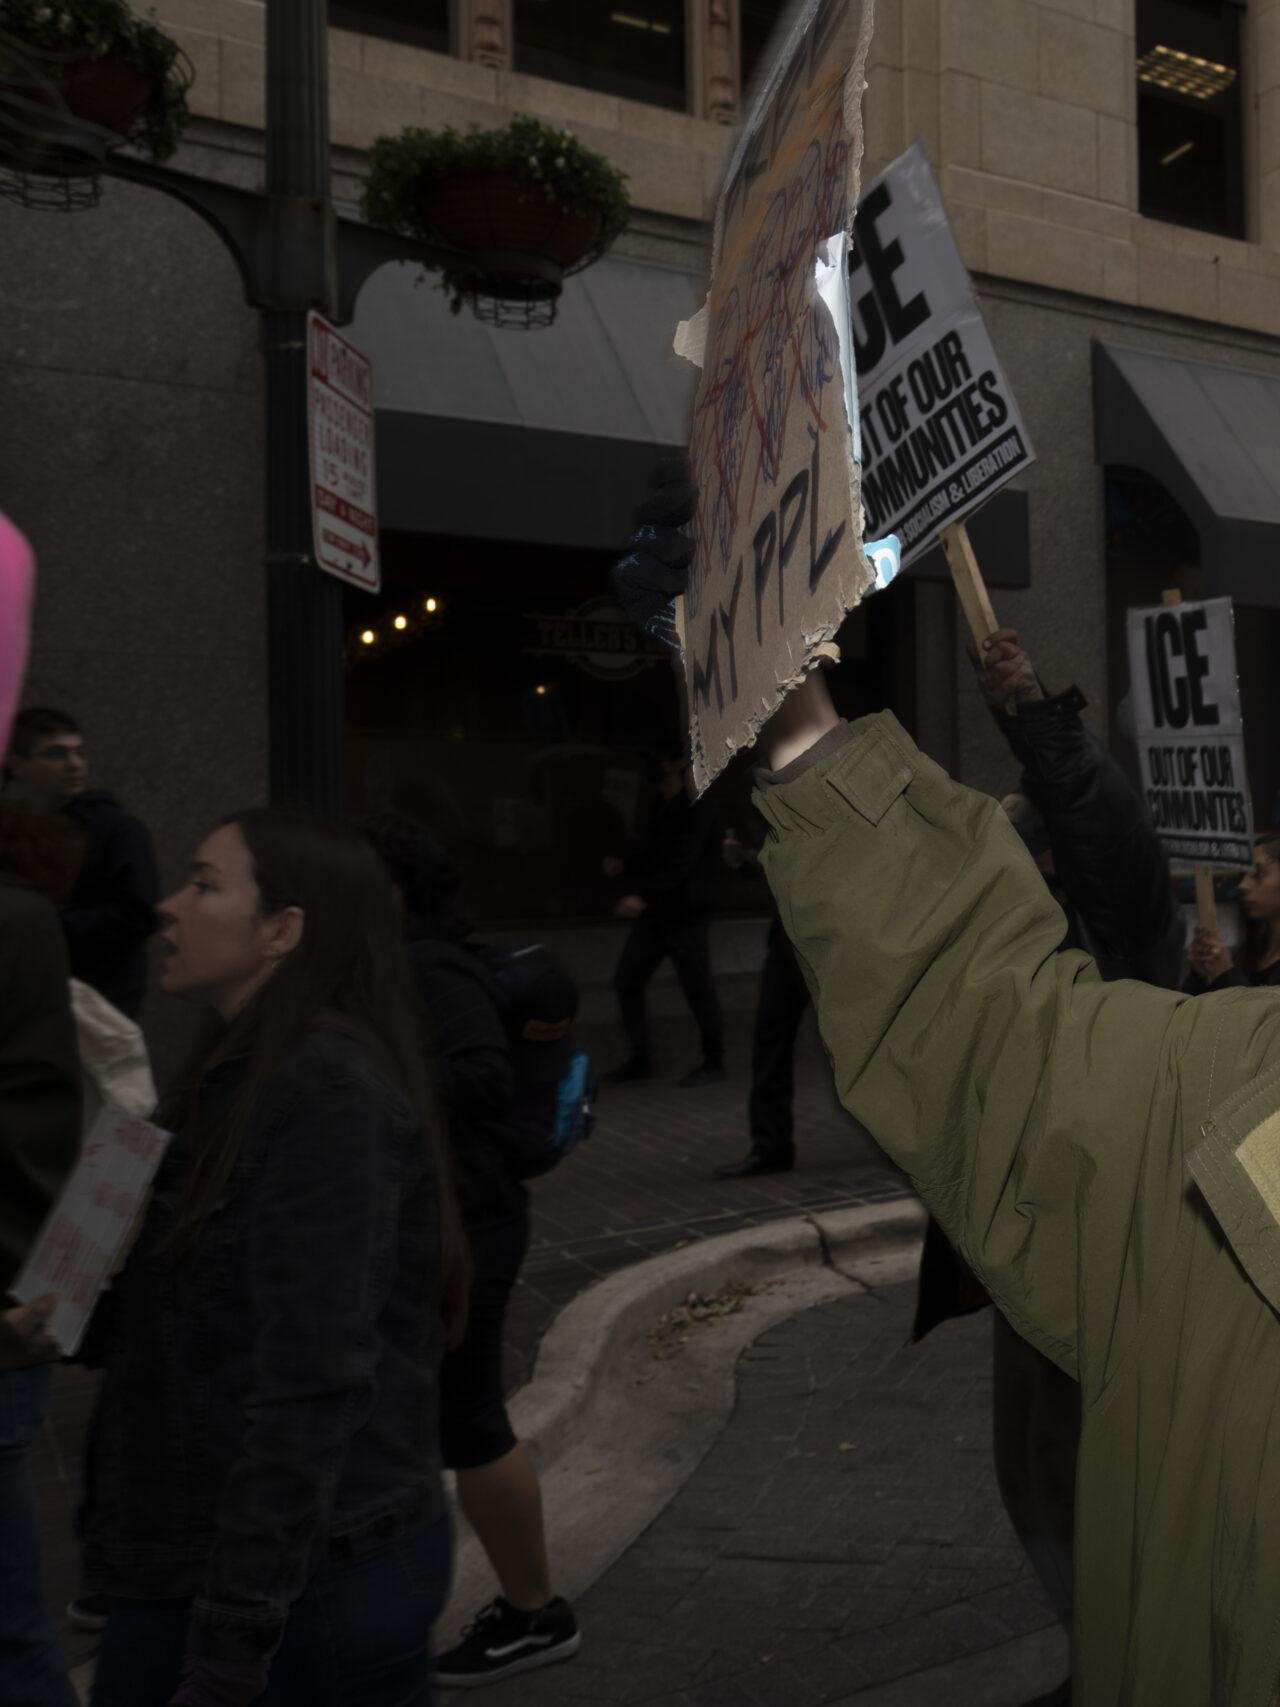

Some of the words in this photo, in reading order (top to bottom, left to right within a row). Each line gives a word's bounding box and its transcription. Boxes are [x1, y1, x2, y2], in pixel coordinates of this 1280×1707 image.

[876, 377, 908, 442] OF
[907, 330, 971, 419] OUR
[862, 370, 1008, 536] OMMUNITIES
[949, 483, 966, 503] &
[961, 436, 1022, 493] LIBERATION
[692, 557, 743, 718] MY
[753, 428, 846, 646] PPL
[1145, 609, 1219, 729] ICE
[1148, 745, 1176, 786] OUT
[1177, 745, 1198, 787] OF
[1200, 745, 1234, 788] OUR
